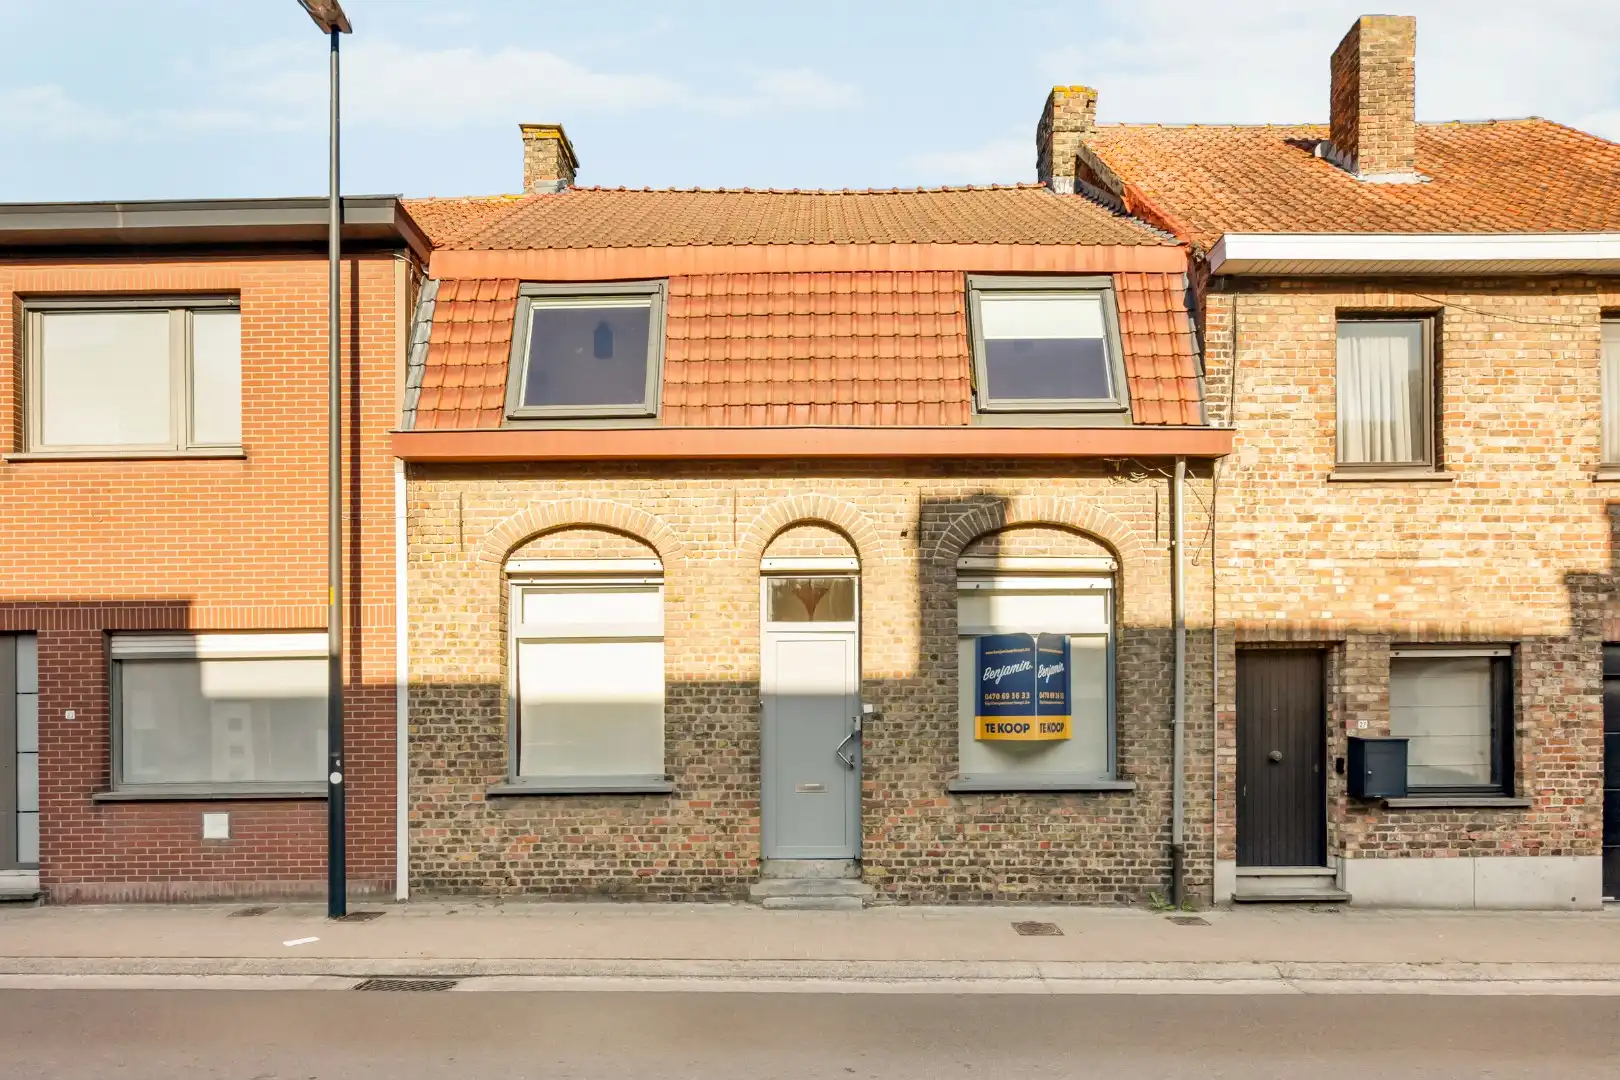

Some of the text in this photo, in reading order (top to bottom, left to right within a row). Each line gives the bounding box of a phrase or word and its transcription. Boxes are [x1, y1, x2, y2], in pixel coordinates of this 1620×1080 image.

[985, 723, 1030, 733] TE KOOP
[1039, 722, 1065, 733] TE KOOP
